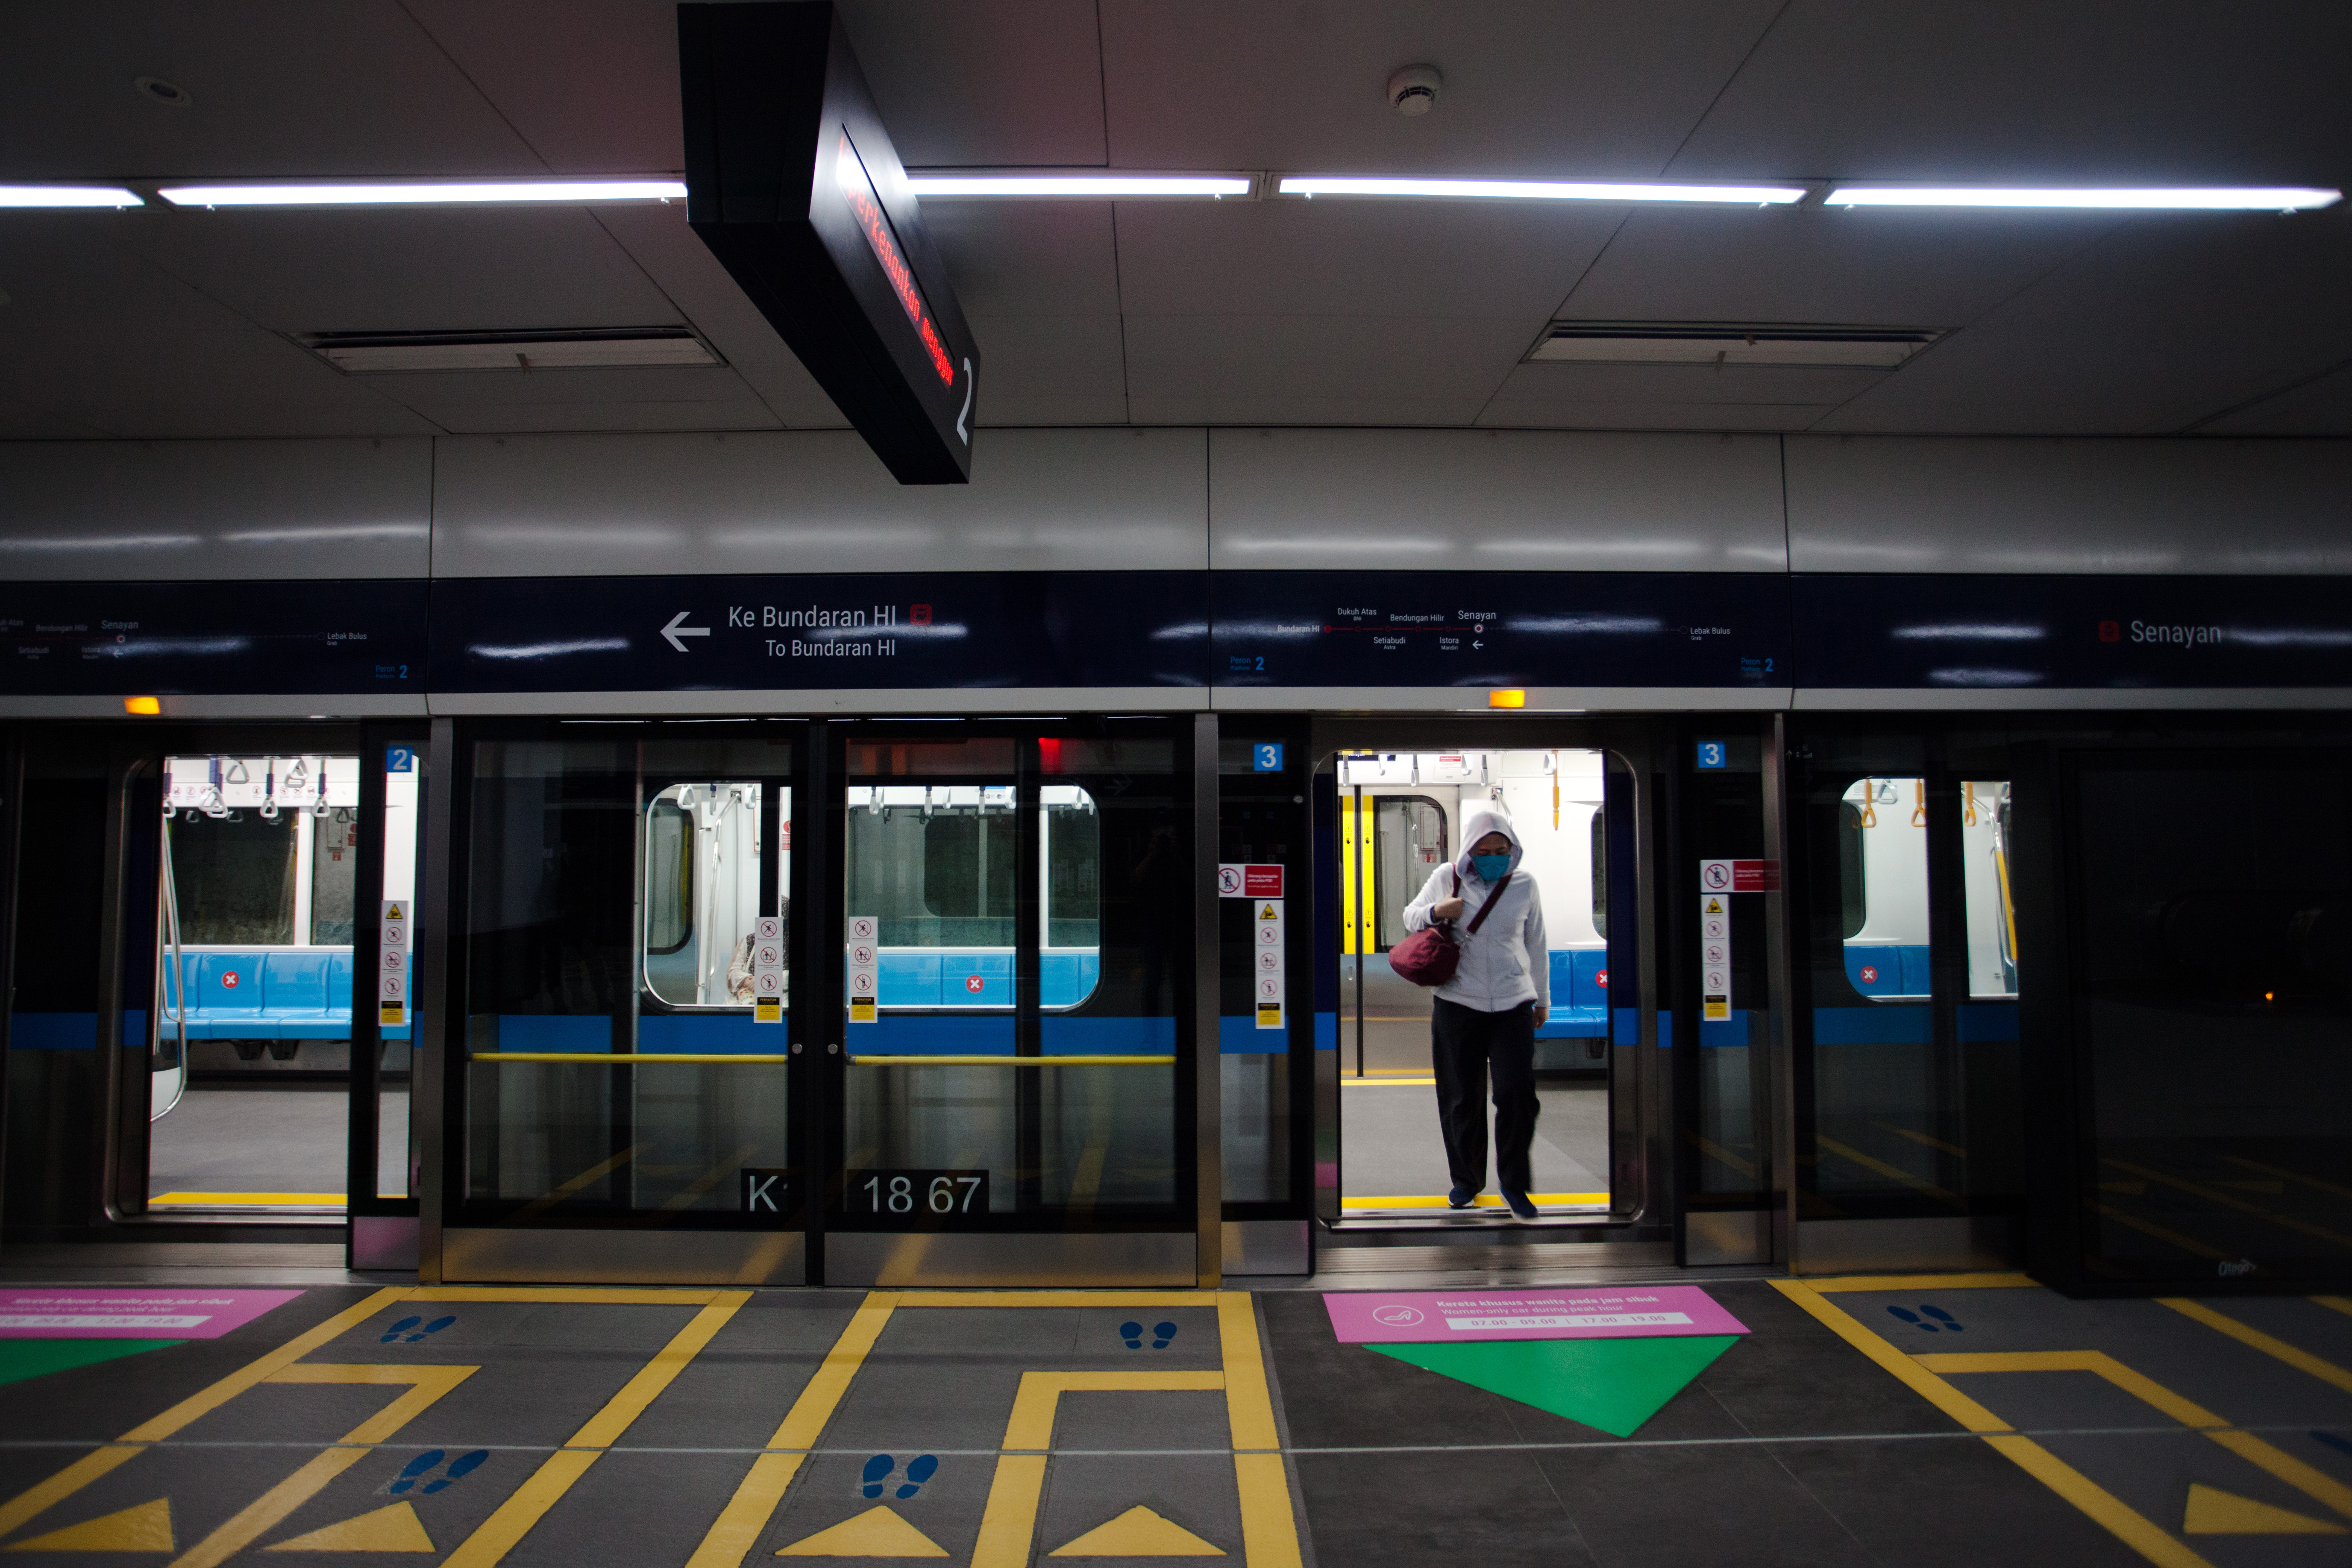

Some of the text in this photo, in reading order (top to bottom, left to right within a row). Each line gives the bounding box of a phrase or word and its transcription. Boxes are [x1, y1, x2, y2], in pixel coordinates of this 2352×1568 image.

[957, 357, 972, 446] 2
[729, 605, 896, 627] Ke Bundaran HI
[1390, 614, 1429, 623] Bendungan
[1458, 610, 1496, 622] Senayan
[101, 620, 139, 631] Senayan
[2131, 620, 2221, 649] Senayan
[766, 640, 895, 656] To Bundaran HI
[399, 665, 408, 678] 2
[1255, 656, 1265, 671] 2
[1765, 658, 1773, 672] 2
[393, 749, 407, 770] 2
[1261, 746, 1276, 767] 3
[1705, 743, 1720, 765] 3
[863, 1176, 913, 1213] 18
[928, 1176, 981, 1213] 67
